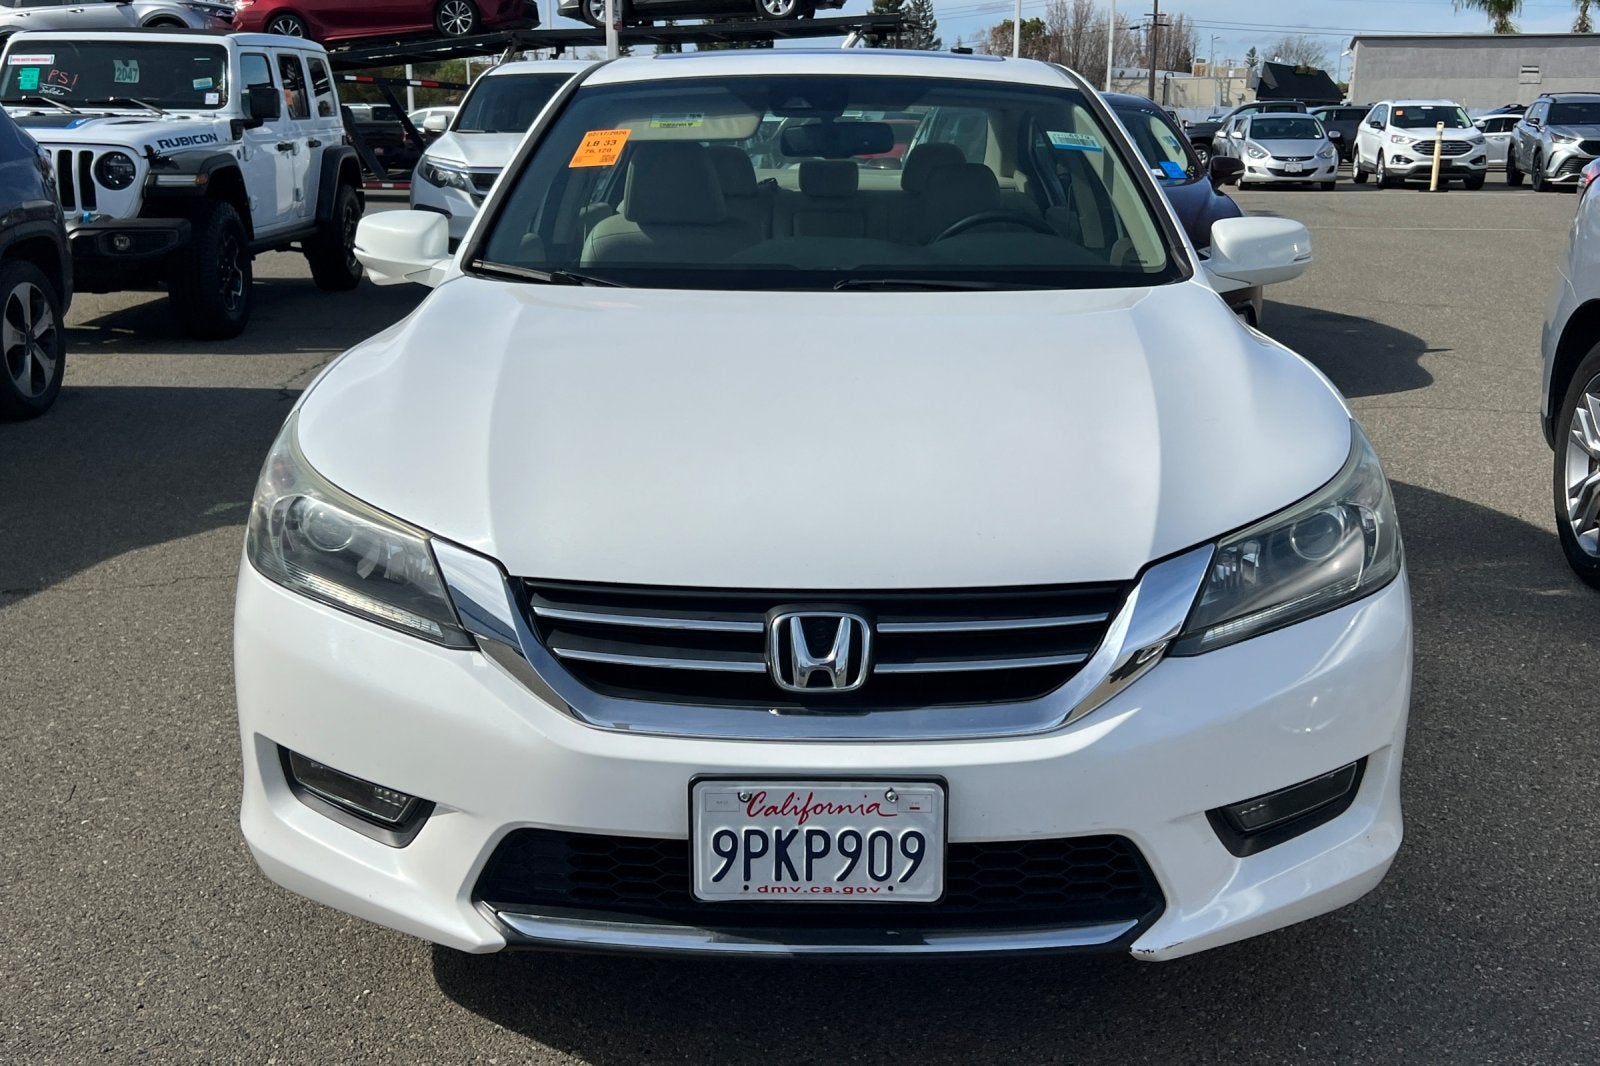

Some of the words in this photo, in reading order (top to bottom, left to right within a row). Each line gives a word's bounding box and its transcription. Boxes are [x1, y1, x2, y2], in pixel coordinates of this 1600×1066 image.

[157, 133, 219, 149] RUBICON
[746, 791, 898, 825] California
[711, 828, 926, 883] 9PKP909
[757, 885, 881, 895] dmv.ca.gov
